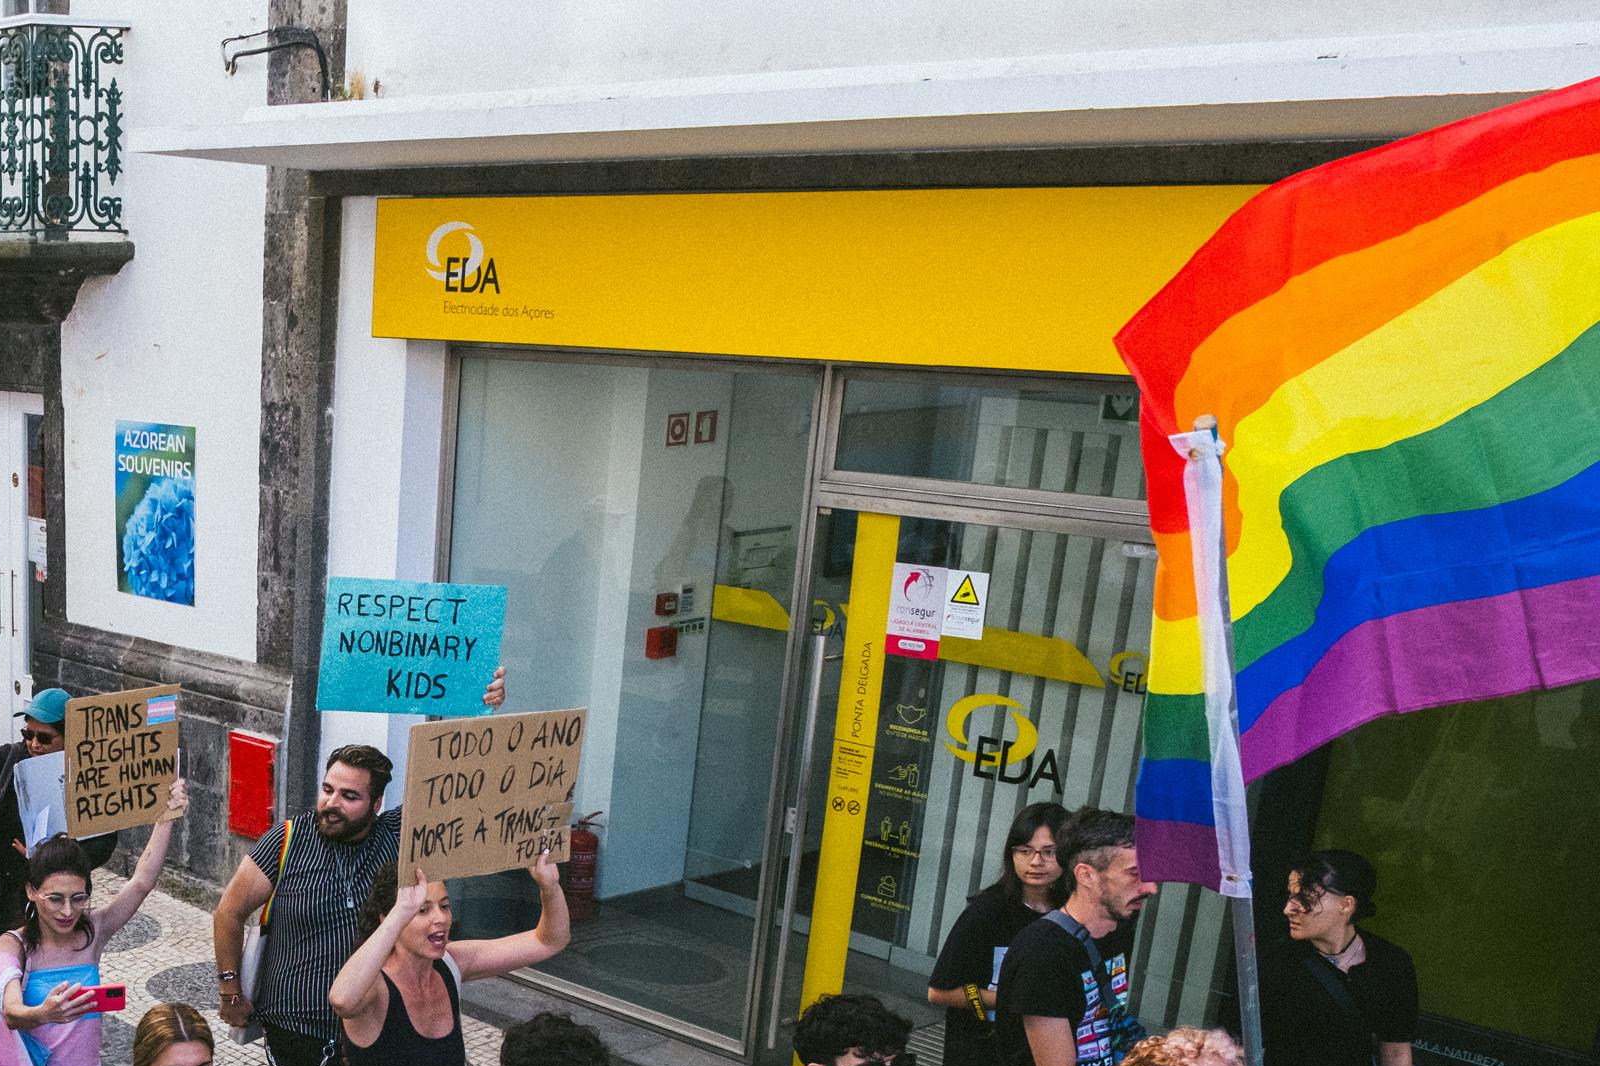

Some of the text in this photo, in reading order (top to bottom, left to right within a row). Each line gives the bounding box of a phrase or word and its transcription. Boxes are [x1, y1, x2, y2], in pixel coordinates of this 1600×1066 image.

[445, 256, 501, 295] EDA
[443, 300, 556, 321] Electricidade dos Açores
[123, 428, 187, 454] AZOREAN
[118, 453, 192, 480] SOUVENIRS
[338, 592, 468, 625] RESPECT
[339, 630, 478, 662] NONBINARY
[386, 669, 449, 699] KIDS
[851, 699, 865, 738] PONTA
[858, 641, 873, 695] DELGADA
[75, 702, 143, 741] TRANS
[429, 715, 582, 761] TODO O ANO
[76, 730, 163, 767] RIGHTS
[973, 735, 1063, 795] EDA
[75, 755, 175, 792] ARE HUMAN
[422, 768, 485, 808] TODO
[499, 764, 516, 794] O
[76, 782, 161, 823] RIGHTS
[410, 816, 465, 863] MORTE
[1432, 1043, 1441, 1054] A
